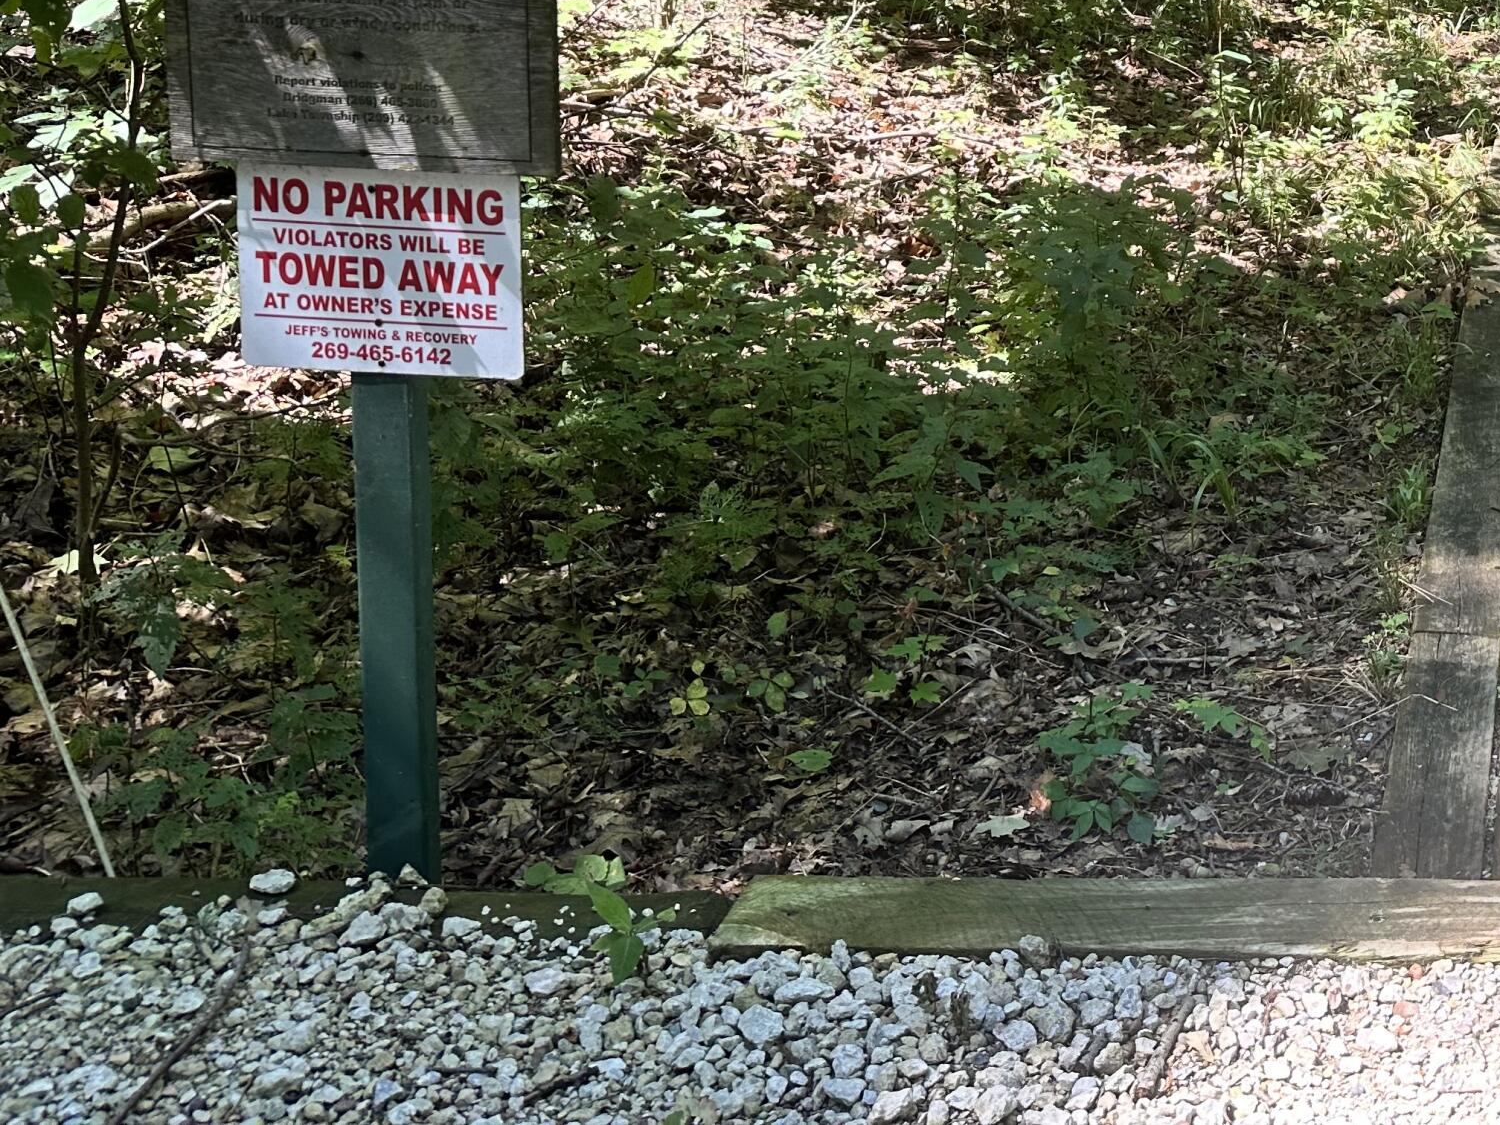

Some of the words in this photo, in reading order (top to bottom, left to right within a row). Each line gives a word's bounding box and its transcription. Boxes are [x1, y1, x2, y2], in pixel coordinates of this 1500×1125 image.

[290, 14, 314, 30] dry
[275, 75, 316, 87] Report
[320, 77, 380, 88] violations
[383, 81, 396, 90] to
[283, 92, 342, 105] Bridgman
[253, 176, 309, 215] NO
[324, 180, 504, 226] PARKING
[273, 227, 392, 251] VIOLATORS
[398, 235, 450, 254] WILL
[458, 238, 485, 256] BE
[255, 251, 385, 290] TOWED
[398, 259, 504, 296] AWAY
[264, 292, 290, 309] AT
[297, 294, 392, 316] OWNER'S
[400, 300, 497, 321] EXPENSE
[285, 324, 329, 338] JEFF'S
[332, 327, 386, 341] TOWING
[392, 331, 401, 341] &
[406, 331, 477, 345] RECOVERY
[311, 341, 452, 365] 269-465-6142
